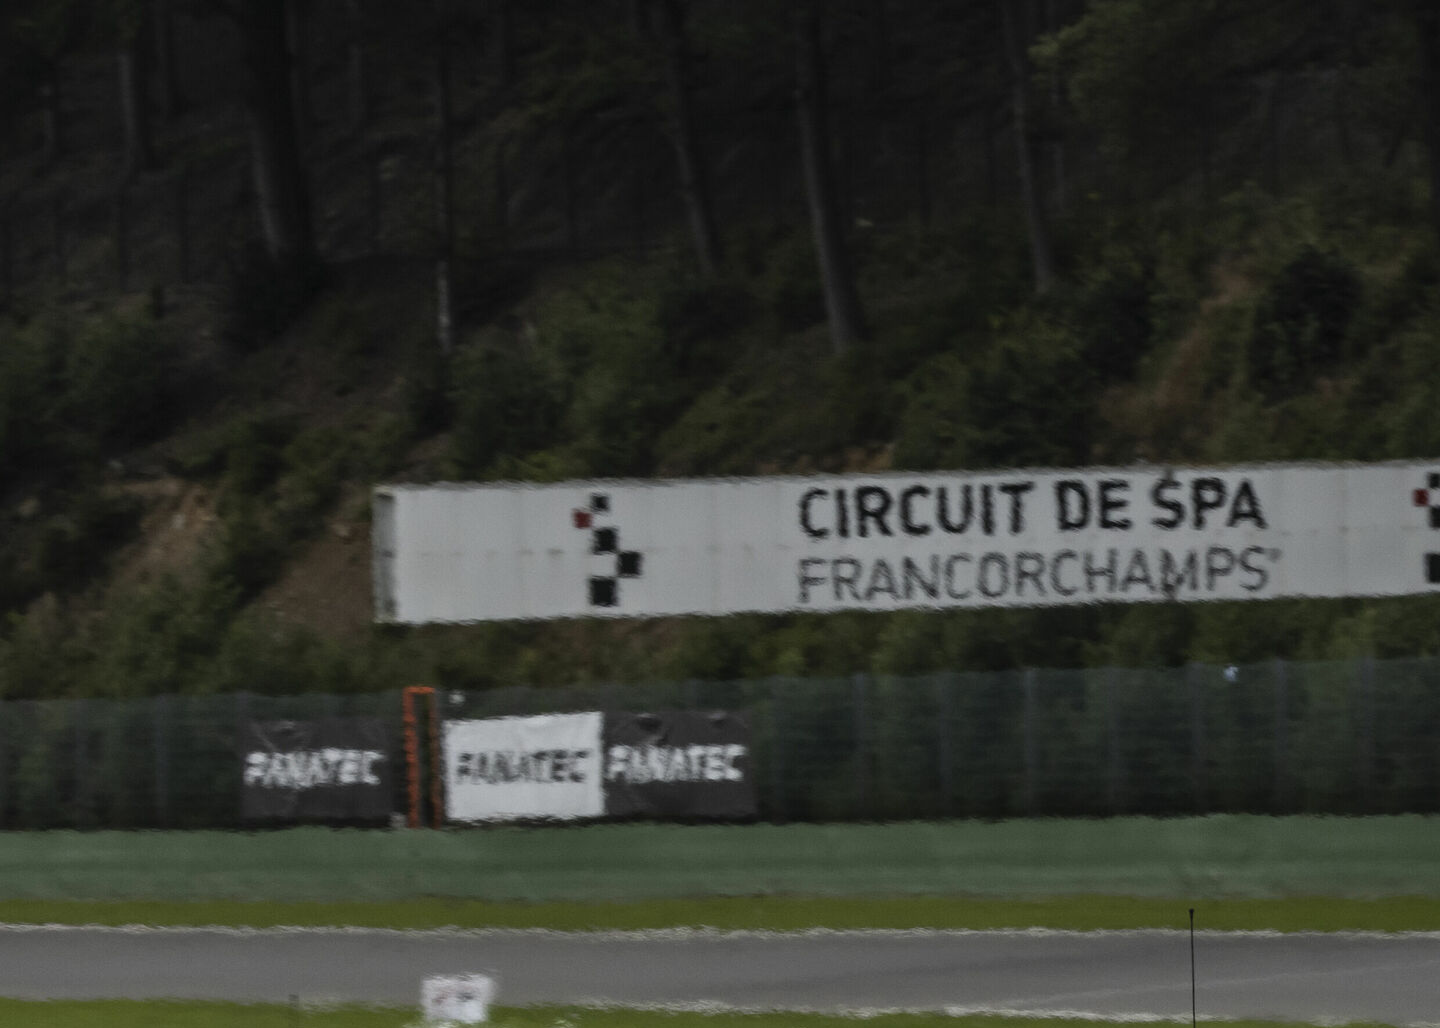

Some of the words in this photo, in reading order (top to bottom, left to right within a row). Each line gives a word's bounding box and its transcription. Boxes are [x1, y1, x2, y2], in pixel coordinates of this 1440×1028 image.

[799, 480, 1035, 539] CIRCUIT
[1054, 478, 1133, 533] DE
[1152, 475, 1268, 531] SPA
[798, 544, 1270, 602] FRANCORCHAMPS
[245, 747, 386, 787] FANATEC
[456, 749, 593, 786] FANATEC
[607, 744, 746, 783] FANATEC
